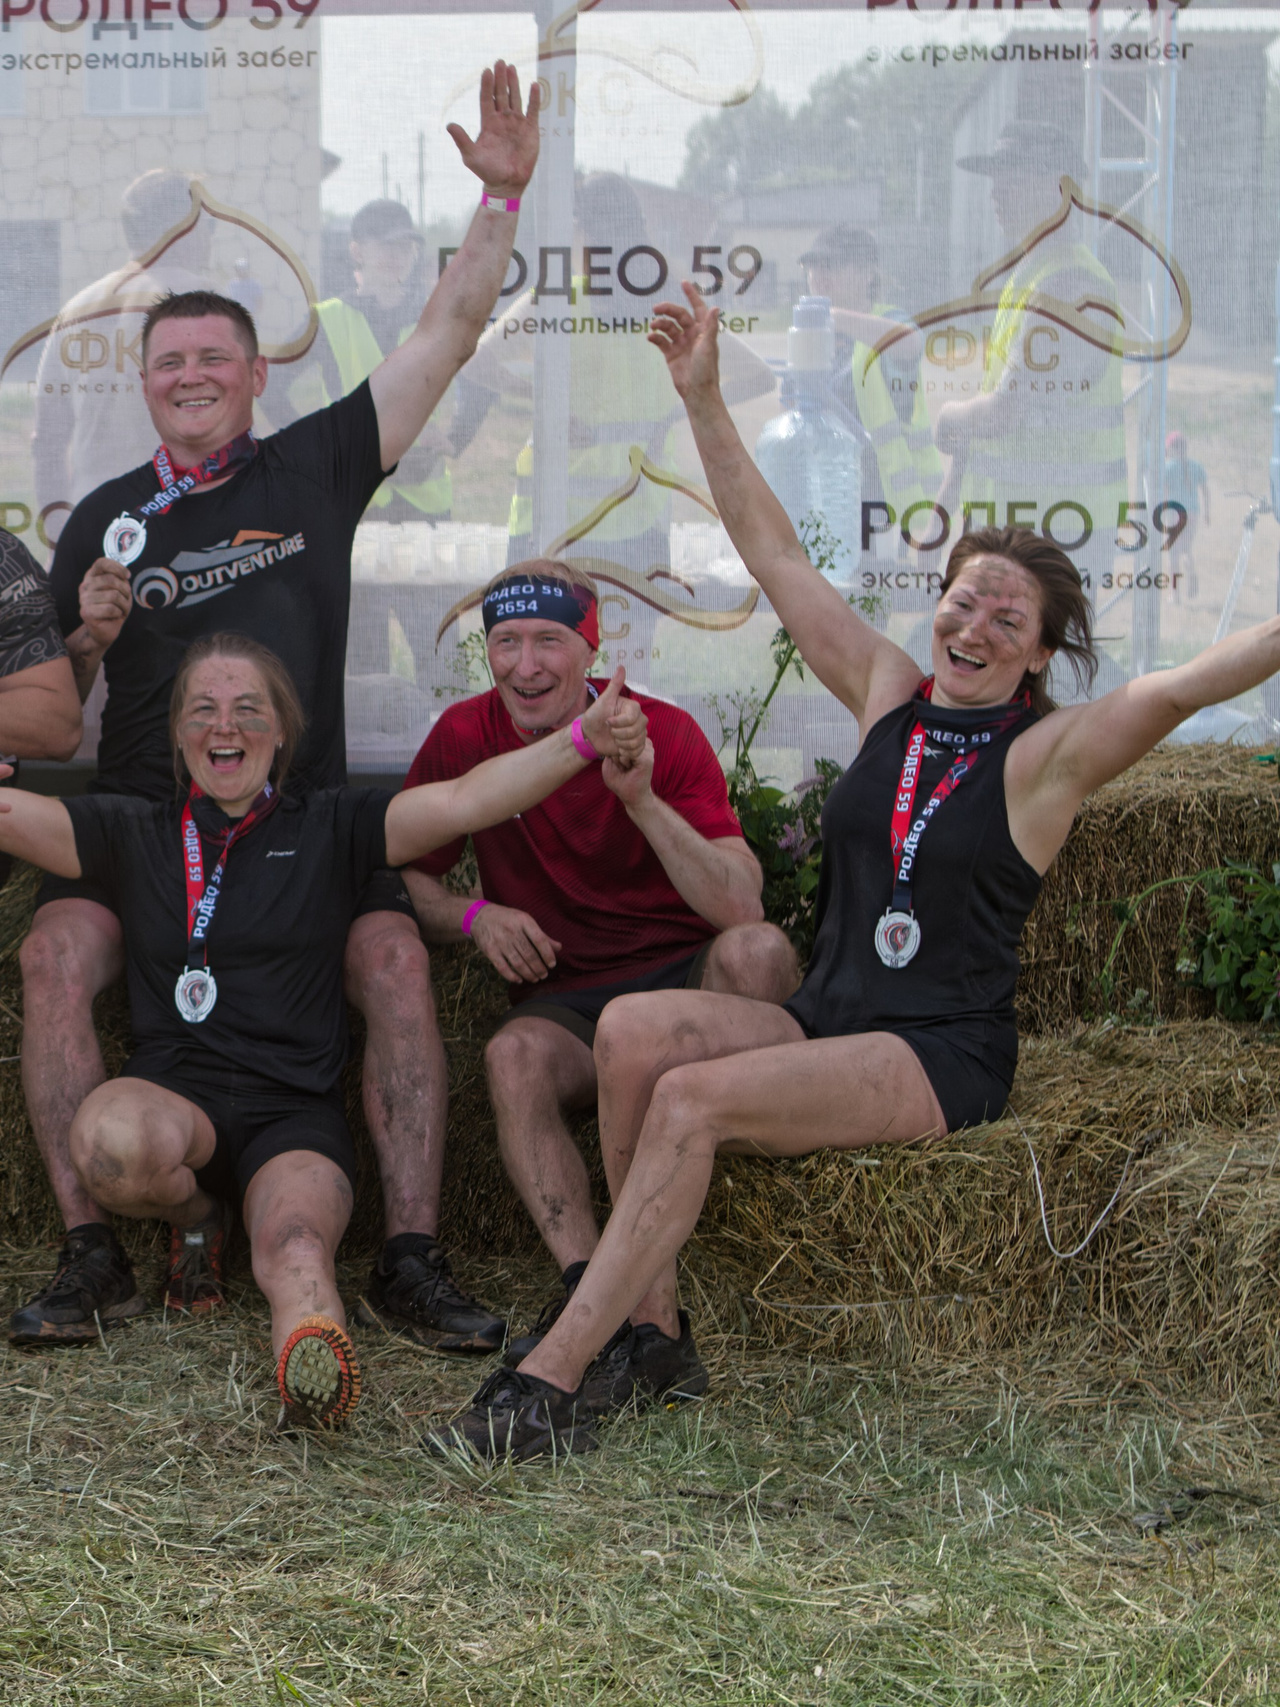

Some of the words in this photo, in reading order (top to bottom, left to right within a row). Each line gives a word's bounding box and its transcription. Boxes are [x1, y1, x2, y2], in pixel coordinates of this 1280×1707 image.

[1, 0, 228, 40] РОДЕО
[249, 0, 320, 31] 59
[1, 48, 227, 75] экстремальный
[237, 46, 318, 68] забег
[866, 39, 1099, 67] экстремальный
[1109, 38, 1194, 61] забег
[692, 245, 763, 297] 59
[925, 326, 1060, 373] ФКС
[1030, 378, 1091, 393] край
[140, 486, 182, 516] РОДЕО
[177, 475, 195, 491] 59
[1114, 500, 1188, 551] 59
[181, 531, 306, 592] OUTVENTURE
[1101, 567, 1183, 590] забег
[484, 584, 535, 607] РОДЕО
[541, 585, 563, 597] 59
[496, 600, 538, 617] 2654
[903, 733, 923, 788] РОДЕО
[896, 792, 911, 812] 59
[184, 819, 201, 863] РОДЕО
[898, 820, 926, 882] РОДЕО
[922, 798, 940, 816] 59
[189, 866, 203, 882] 59
[193, 885, 220, 938] РОДЕО
[211, 863, 223, 884] 59
